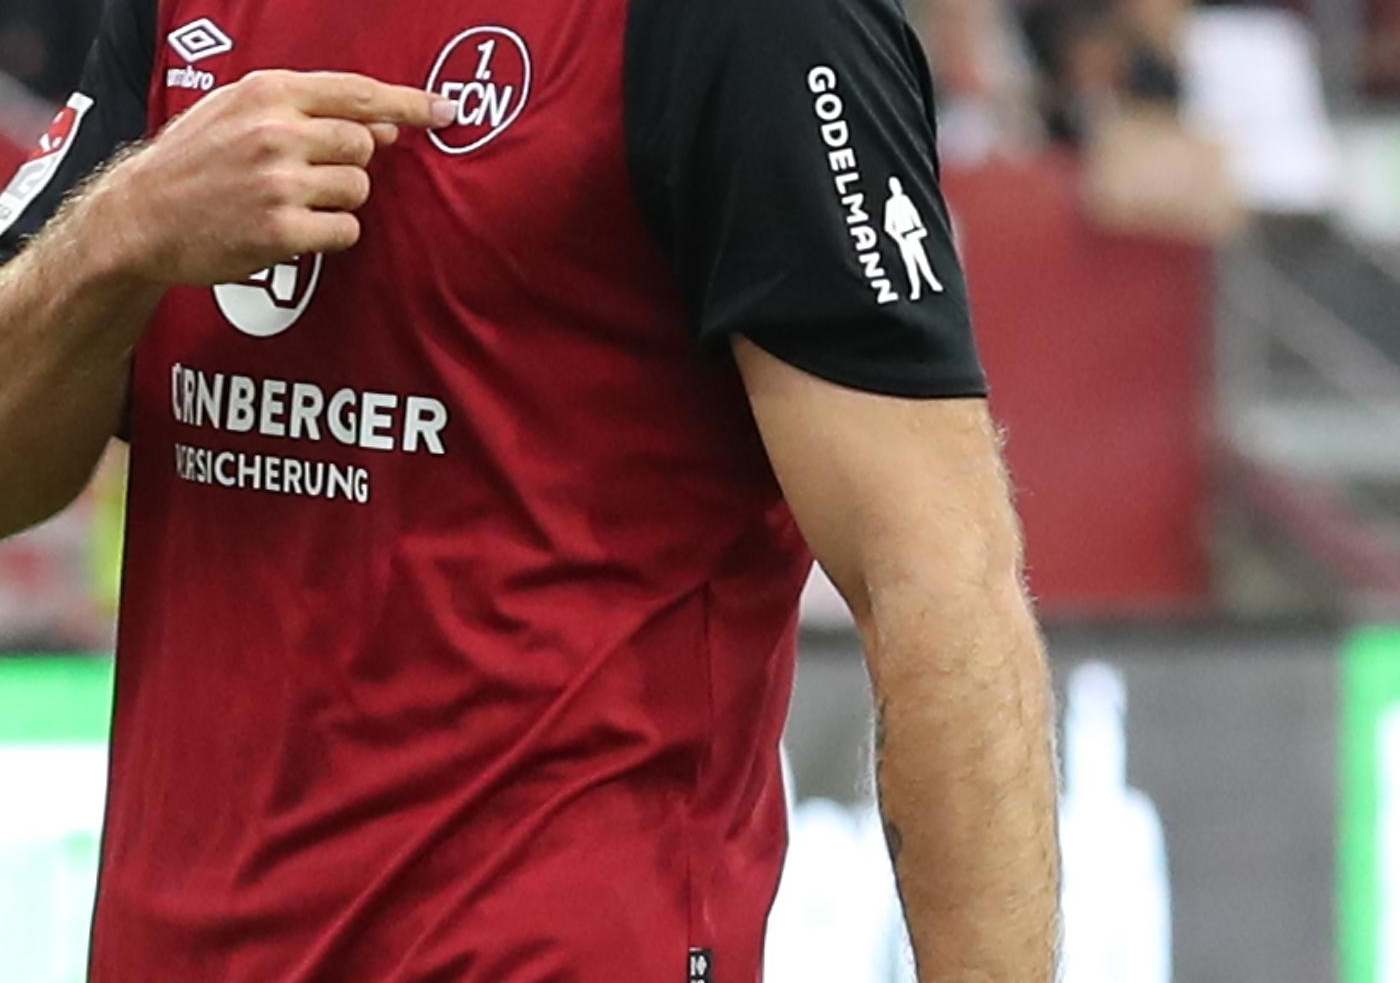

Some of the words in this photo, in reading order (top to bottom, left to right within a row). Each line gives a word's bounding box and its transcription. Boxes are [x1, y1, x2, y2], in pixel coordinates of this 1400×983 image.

[475, 39, 495, 79] 1.
[441, 82, 512, 127] FCN
[807, 65, 898, 305] GODELMANN
